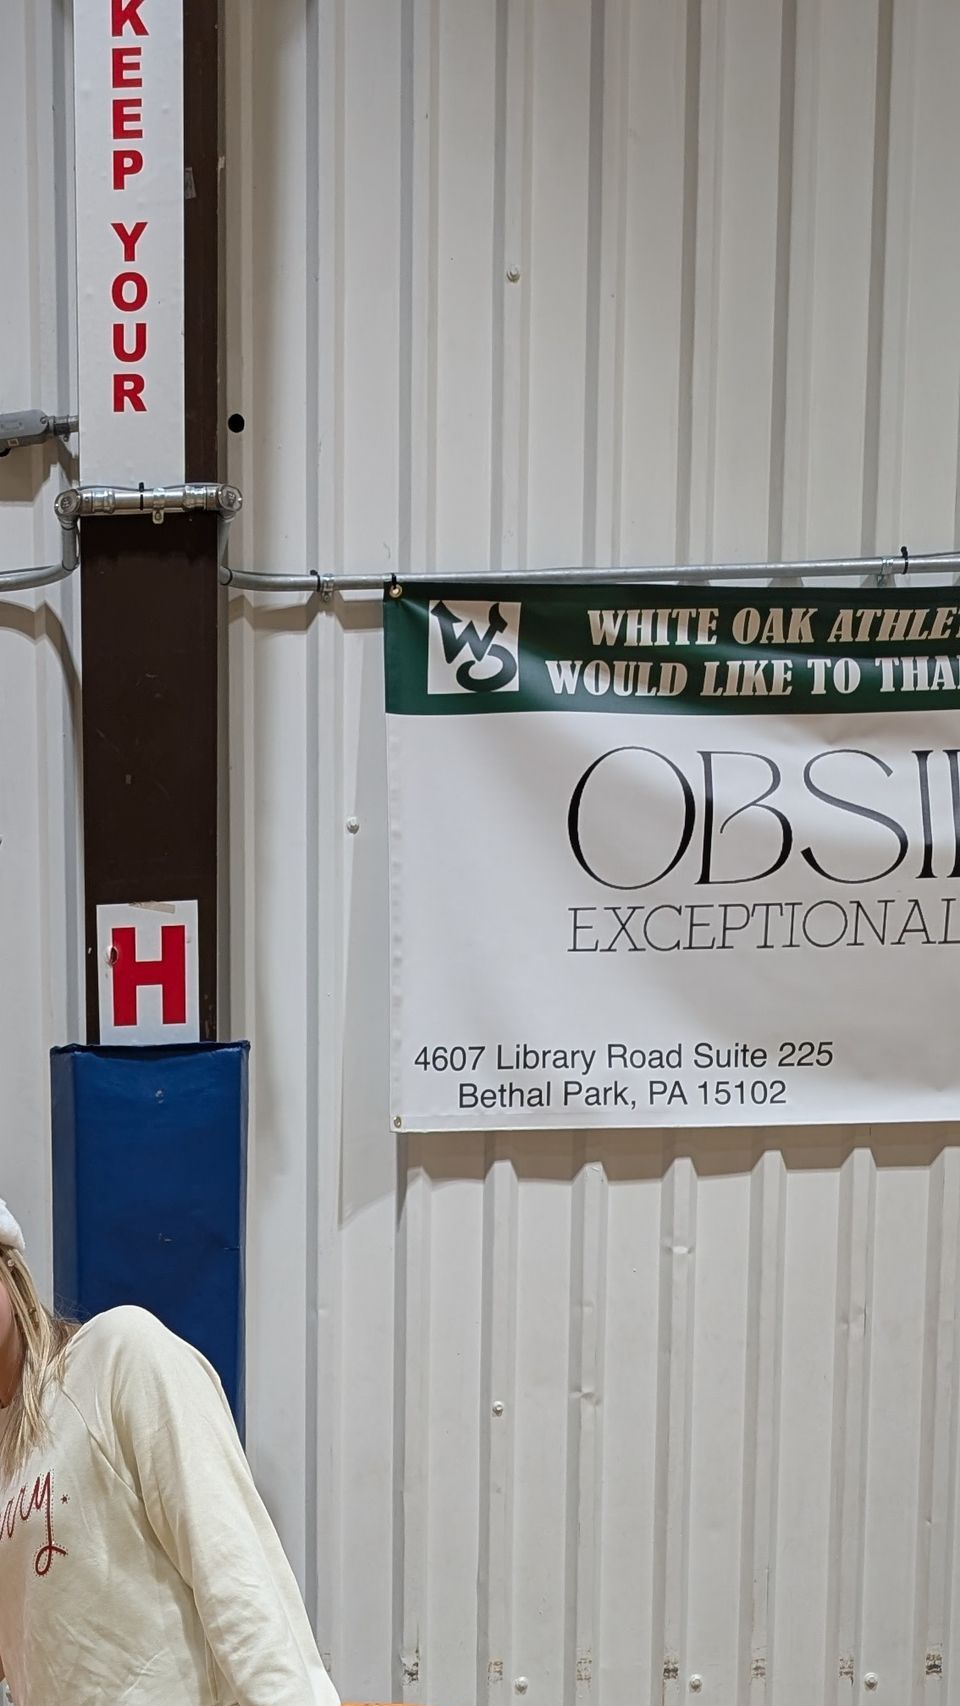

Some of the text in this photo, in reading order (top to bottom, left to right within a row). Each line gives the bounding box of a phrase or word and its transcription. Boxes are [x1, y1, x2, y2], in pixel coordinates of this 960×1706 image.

[111, 0, 149, 413] KEEP YOUR
[587, 607, 960, 647] WHITE OAK ATHLE
[545, 655, 960, 697] WOULD LIKE TO THA
[568, 745, 960, 890] OBSI
[112, 925, 186, 1026] H
[414, 1041, 834, 1076] 4607 Library Road Suite 225
[459, 1079, 787, 1111] Bethal Park, PA 15102
